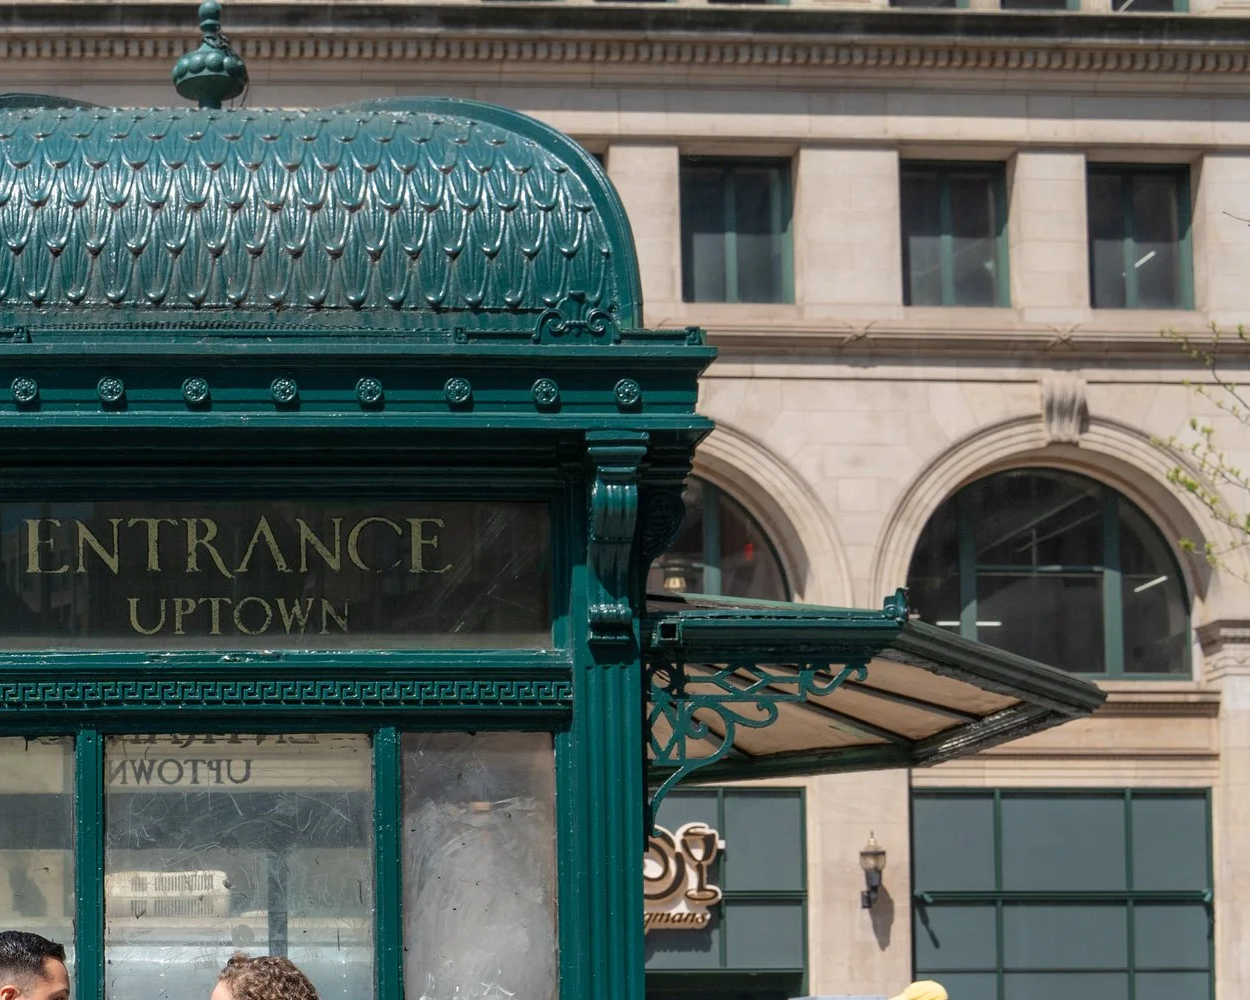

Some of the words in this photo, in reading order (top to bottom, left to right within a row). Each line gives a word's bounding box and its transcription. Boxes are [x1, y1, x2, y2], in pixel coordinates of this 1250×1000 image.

[24, 515, 452, 579] ENTRANCE
[127, 596, 351, 636] UPTOWN
[644, 911, 707, 927] gmans
